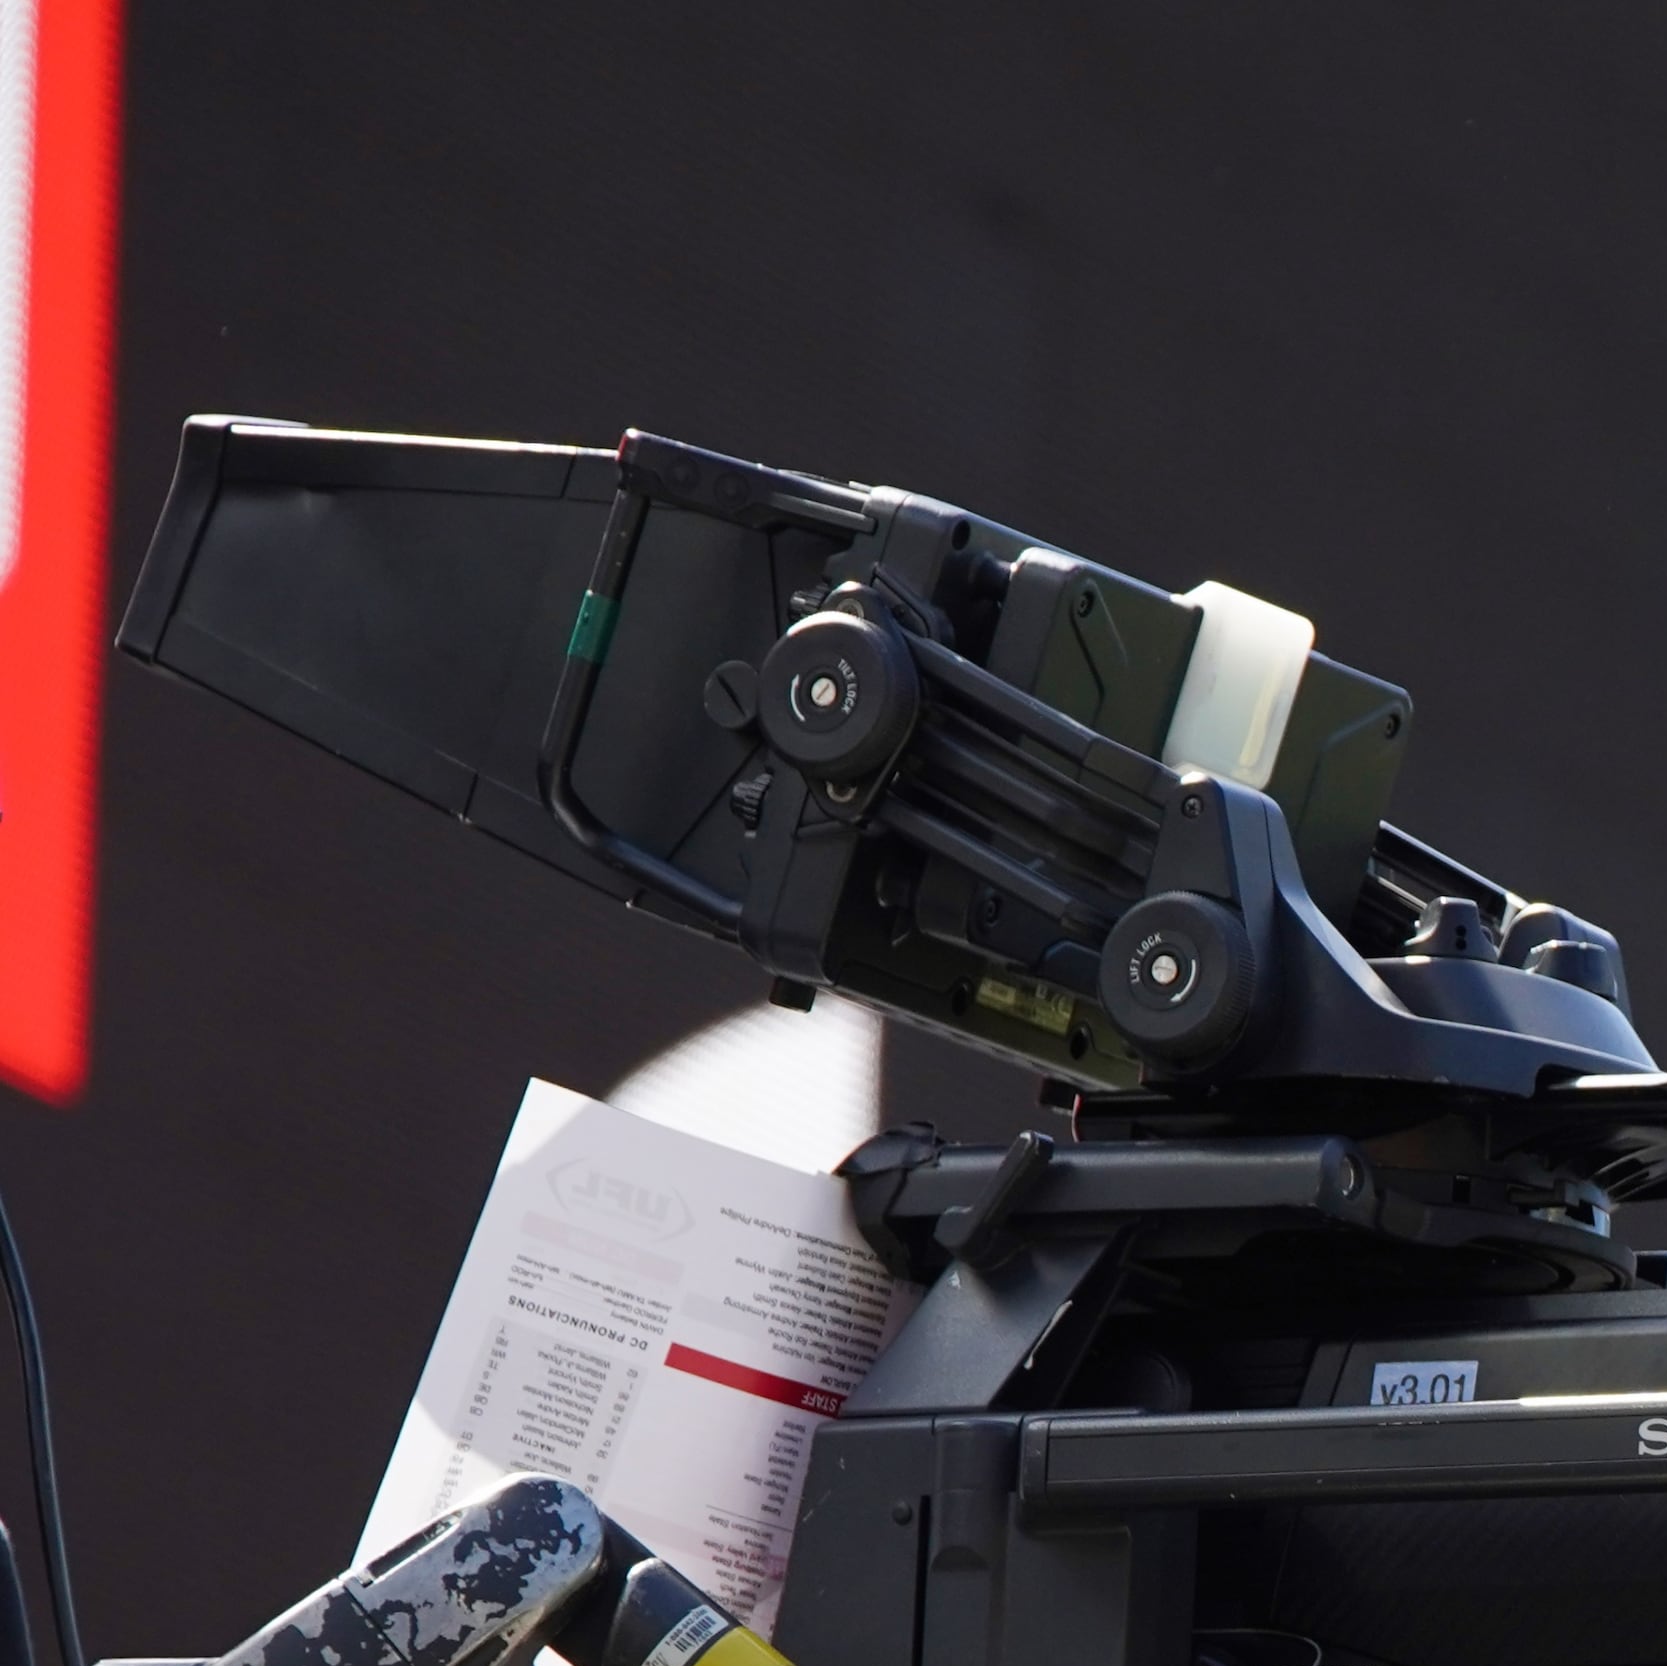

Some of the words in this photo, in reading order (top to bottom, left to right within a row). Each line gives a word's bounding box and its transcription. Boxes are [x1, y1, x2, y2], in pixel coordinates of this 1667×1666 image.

[840, 683, 858, 715] LOCK
[1129, 958, 1141, 984] LIFT
[1135, 931, 1163, 957] LOCK
[506, 1293, 625, 1343] PRONUNCIATIONS
[721, 1295, 770, 1318] Armstrong
[628, 1335, 648, 1351] DC
[799, 1388, 838, 1412] STAFF
[1380, 1373, 1467, 1406] v3.01
[511, 1432, 555, 1453] INACTIVE
